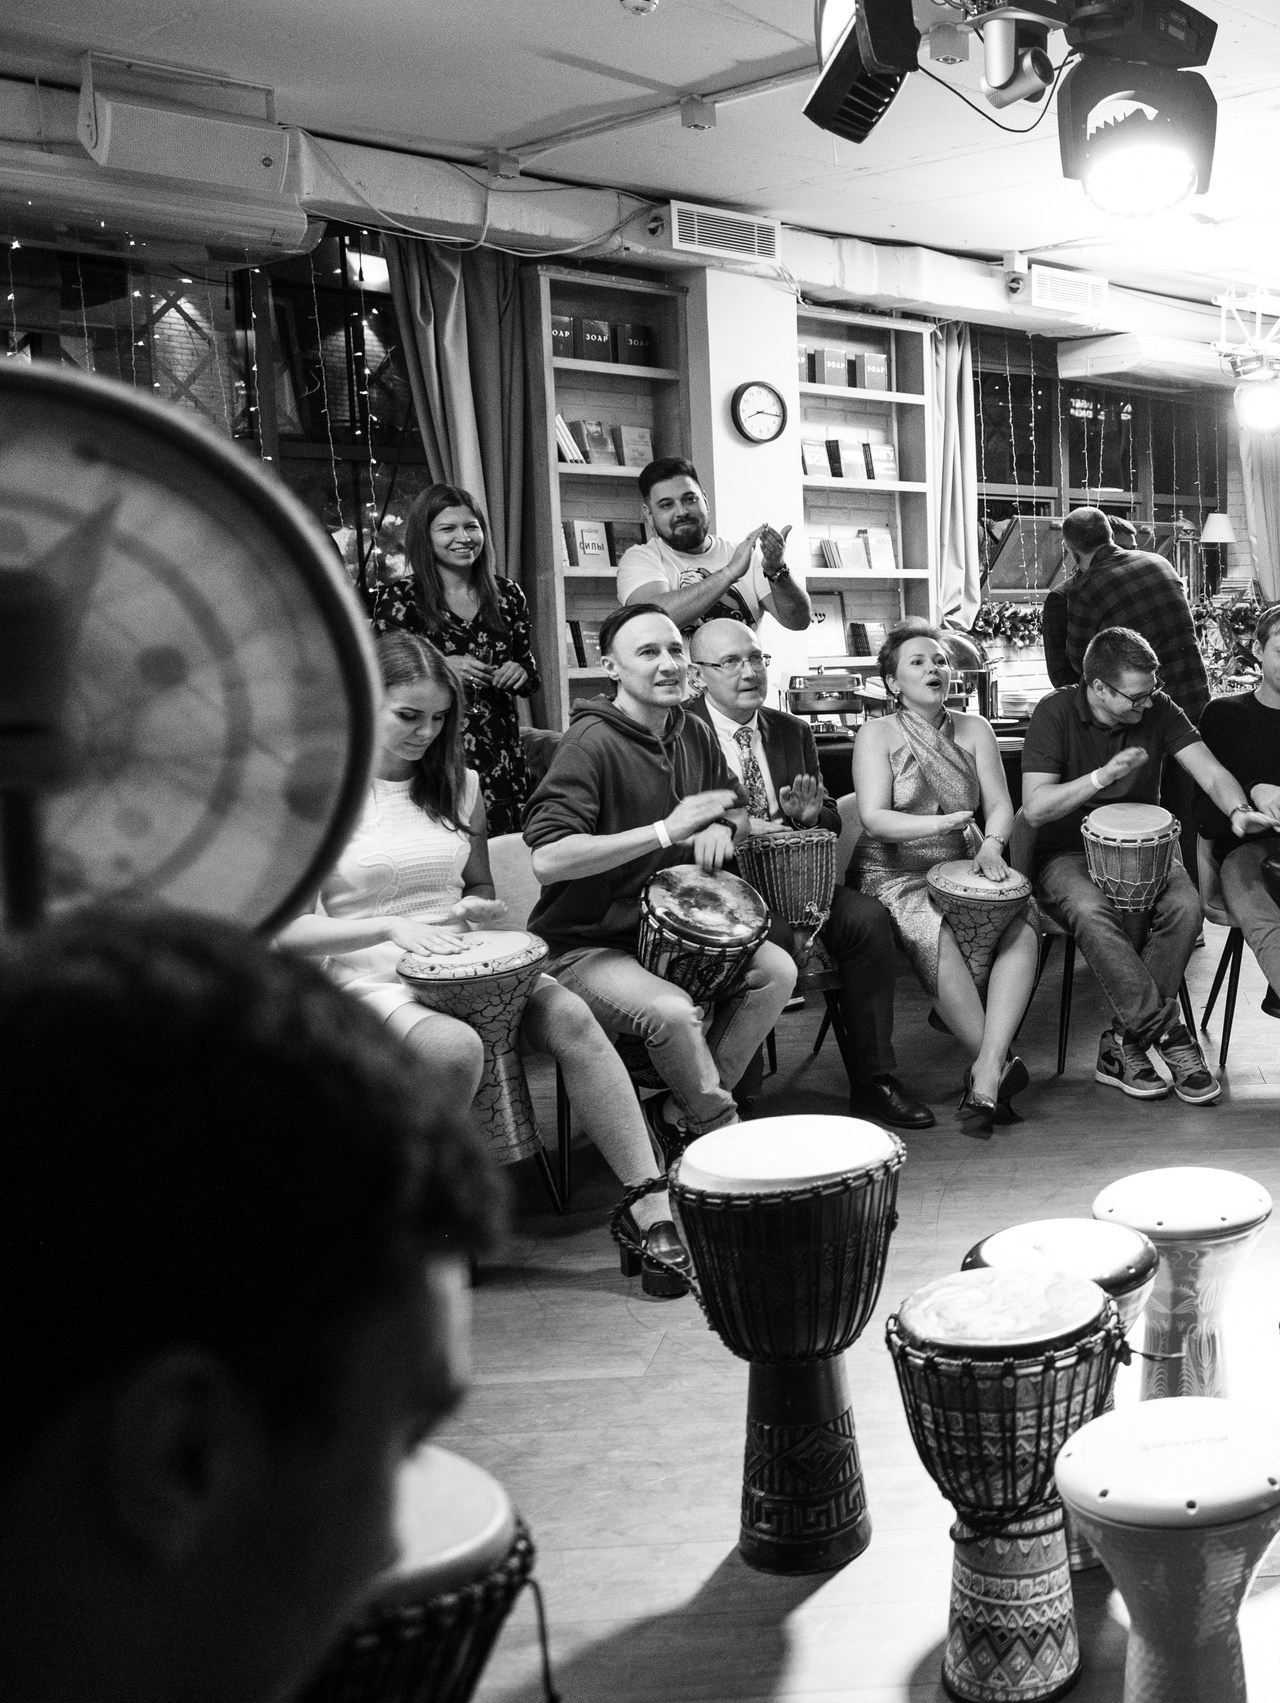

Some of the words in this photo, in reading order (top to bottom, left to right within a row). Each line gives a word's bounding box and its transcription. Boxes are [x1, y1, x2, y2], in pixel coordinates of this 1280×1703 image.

[552, 329, 571, 338] ОАР
[585, 333, 609, 343] ЗОАР
[827, 361, 846, 370] ЗОАР
[866, 365, 885, 374] ЗОАР
[579, 541, 605, 551] СИЛЫ
